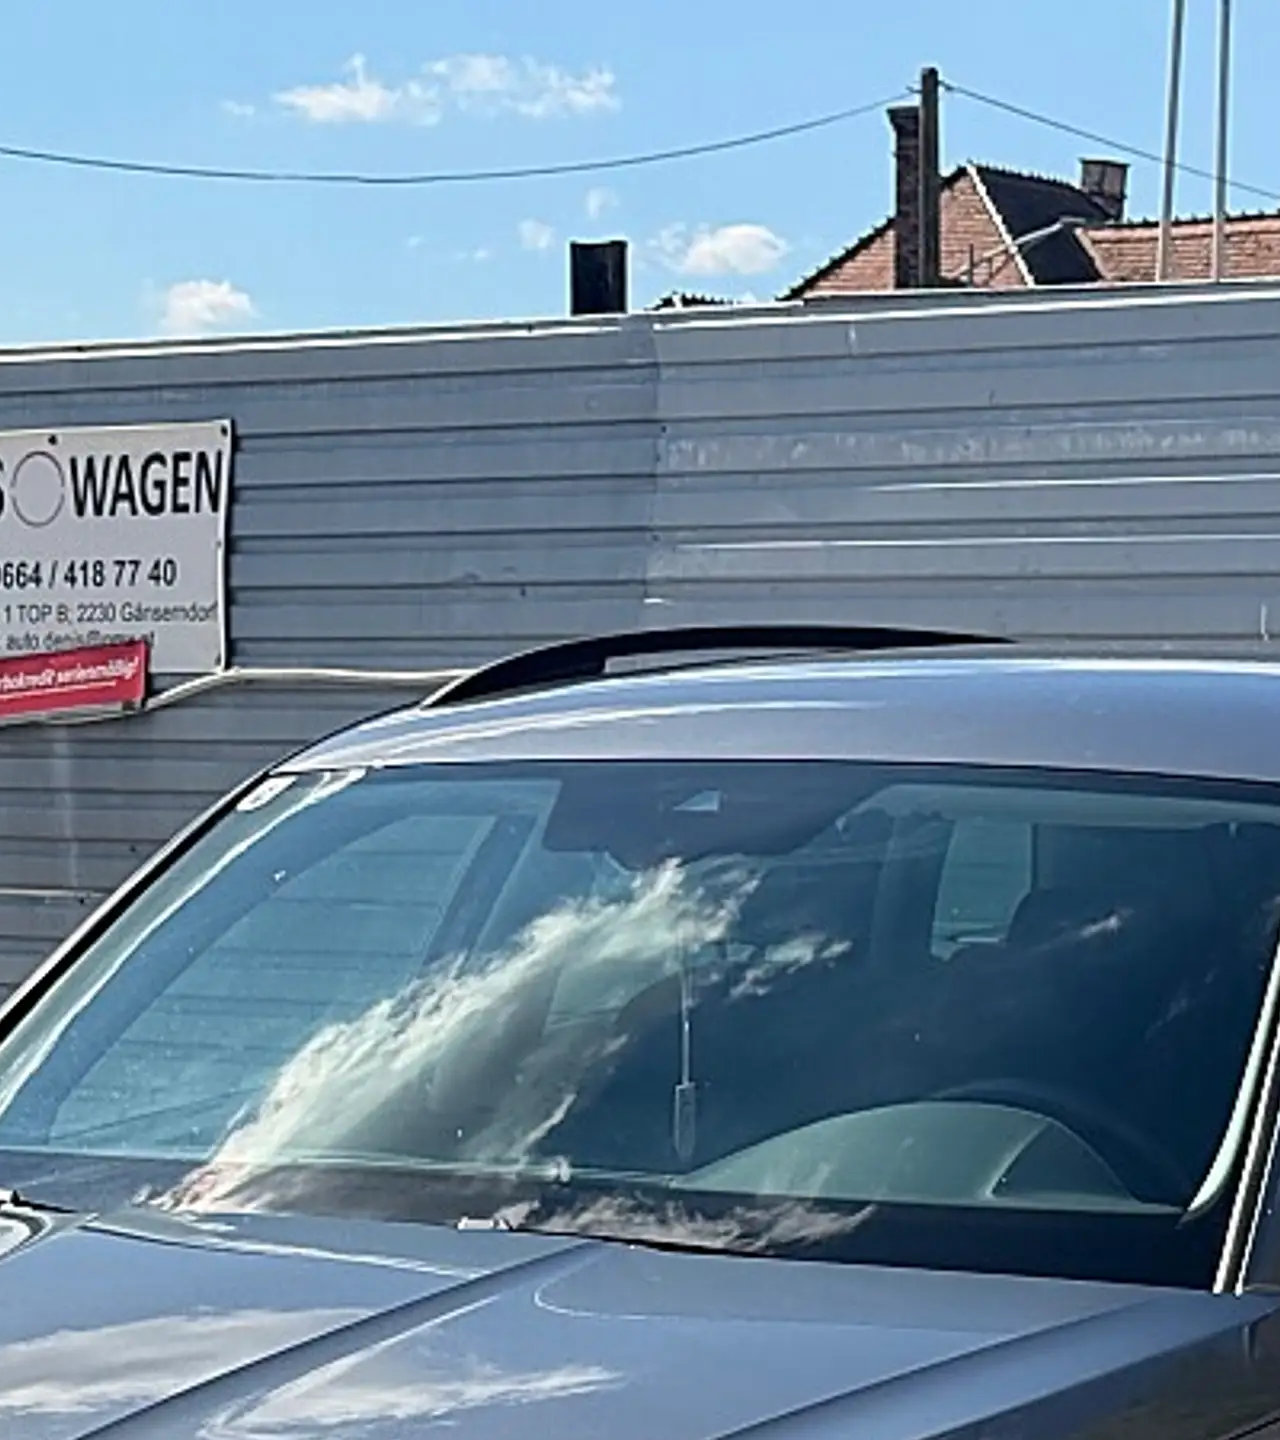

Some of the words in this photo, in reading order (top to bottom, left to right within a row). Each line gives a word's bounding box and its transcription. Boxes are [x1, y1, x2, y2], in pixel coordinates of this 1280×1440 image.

[70, 450, 222, 518] WAGEN
[48, 561, 59, 588] /
[64, 560, 105, 587] 418
[113, 559, 142, 587] 77
[147, 559, 177, 586] 40
[4, 604, 12, 624] 1
[17, 604, 52, 624] TOP
[76, 603, 116, 622] 2230
